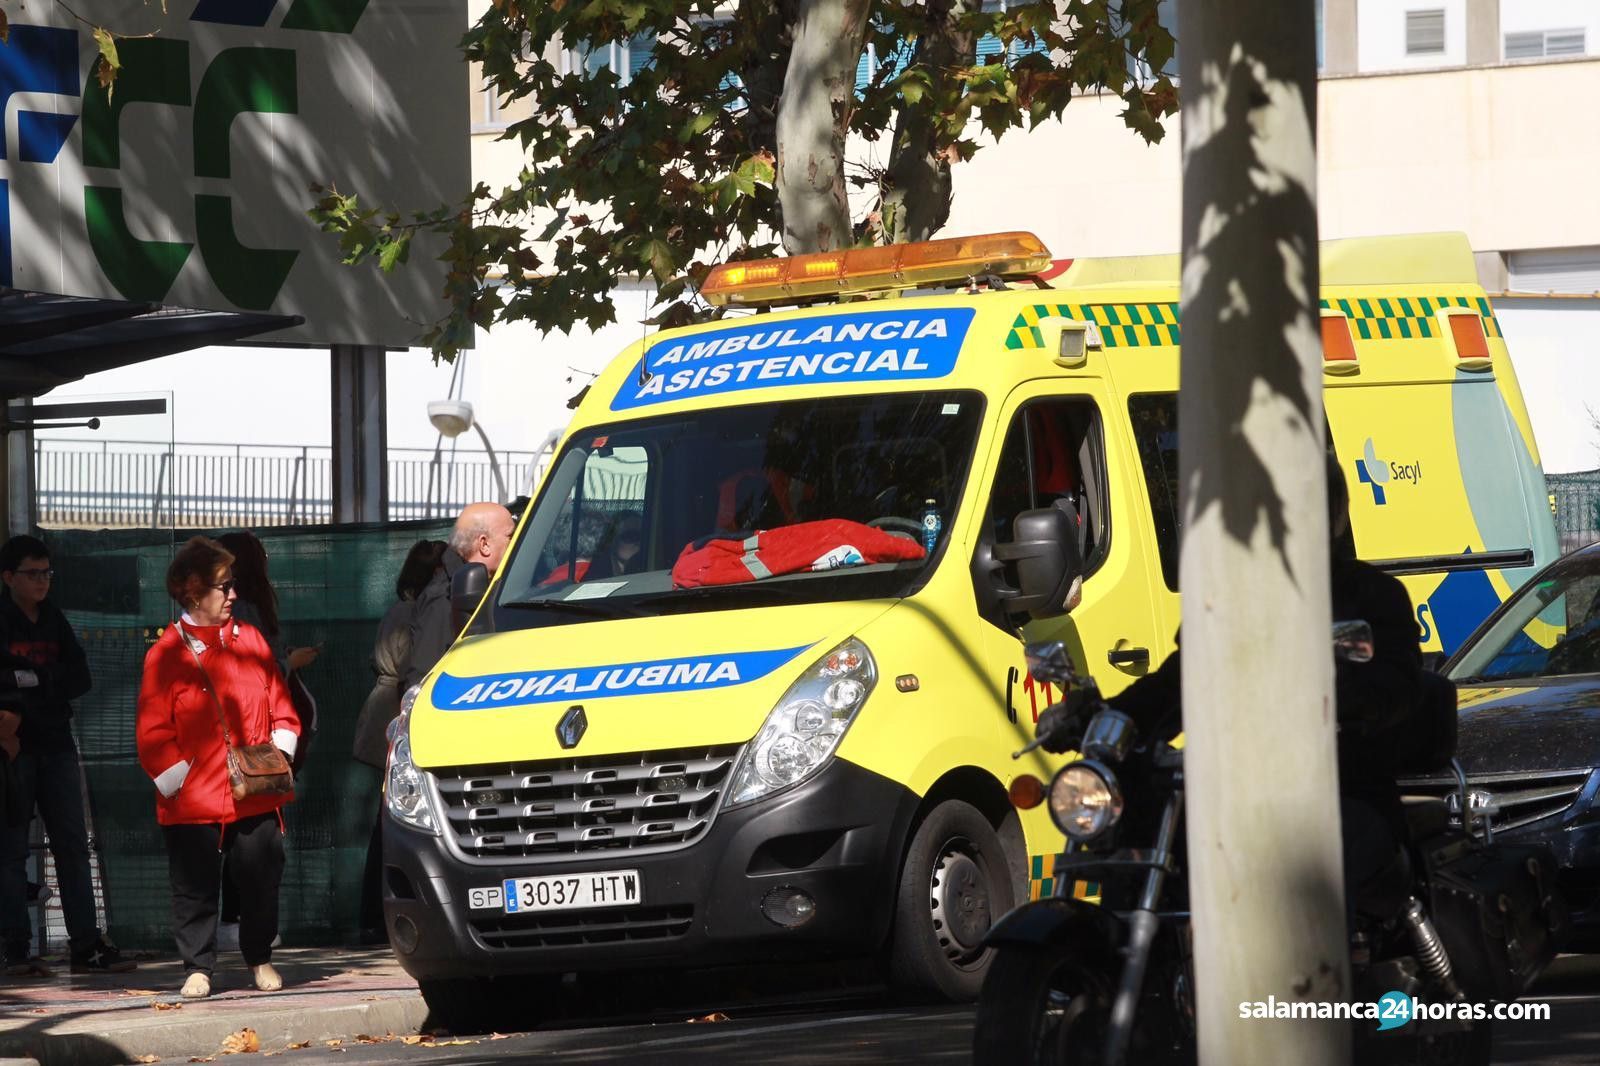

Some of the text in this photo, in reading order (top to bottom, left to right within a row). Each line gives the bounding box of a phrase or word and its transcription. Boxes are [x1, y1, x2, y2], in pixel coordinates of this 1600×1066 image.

[653, 318, 948, 368] AMBULANCIA
[634, 347, 929, 400] ASISTENCIAL
[1390, 460, 1422, 485] Sacyl
[472, 889, 500, 908] SP
[522, 874, 636, 908] 3037 HTW
